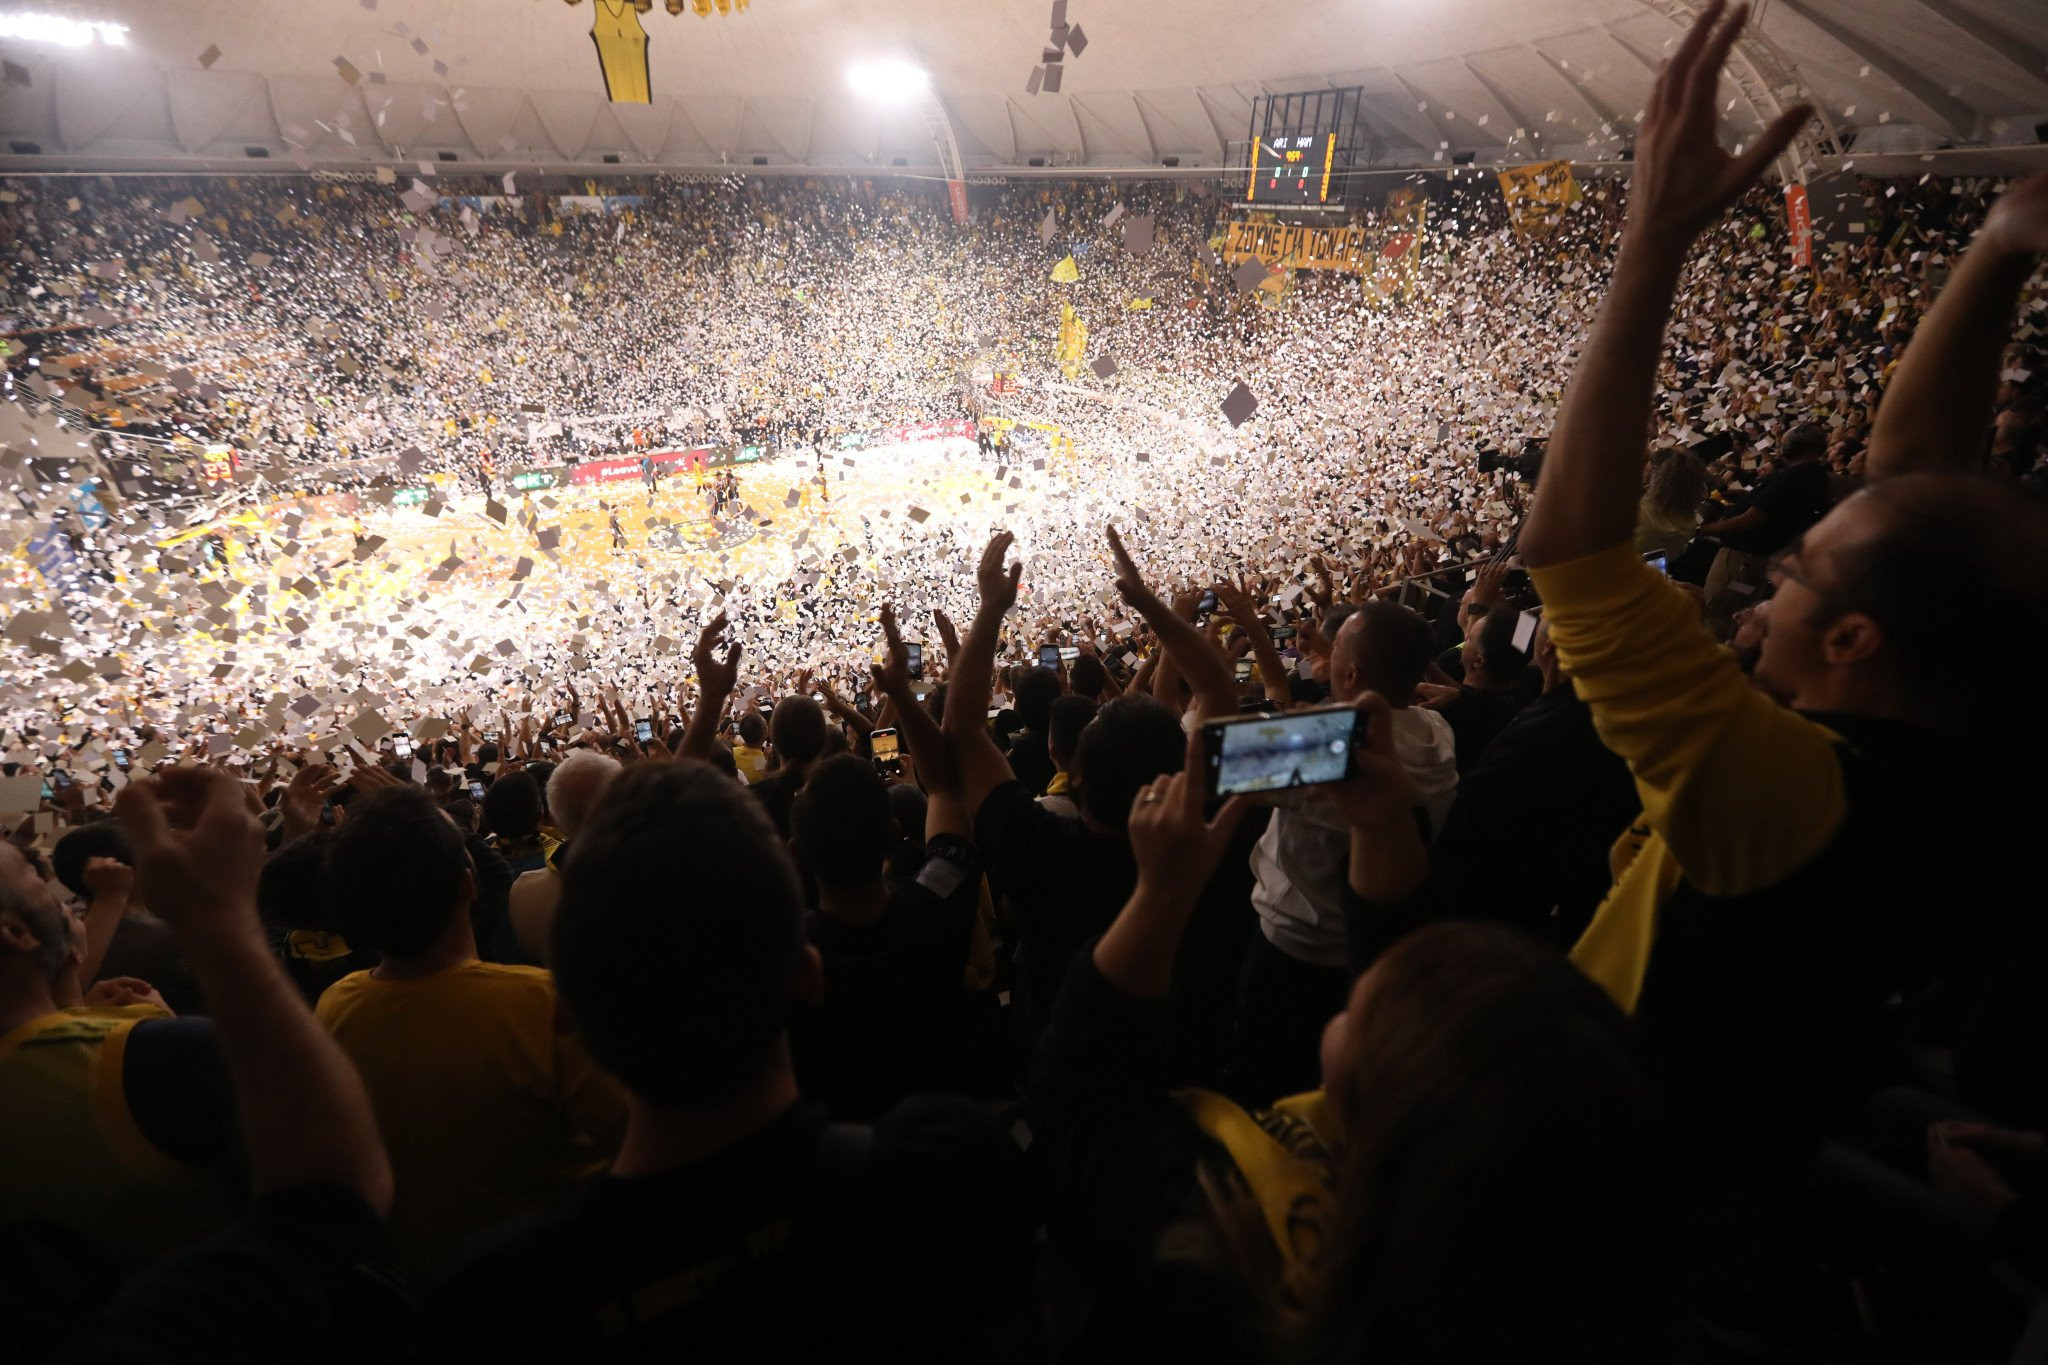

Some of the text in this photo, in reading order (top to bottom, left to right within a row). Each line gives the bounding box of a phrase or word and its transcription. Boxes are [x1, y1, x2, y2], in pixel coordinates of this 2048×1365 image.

[1273, 136, 1312, 149] ARI HAM
[1275, 167, 1281, 177] 0
[1302, 167, 1308, 177] 0
[1270, 179, 1304, 189] 0 0
[207, 462, 232, 479] 23
